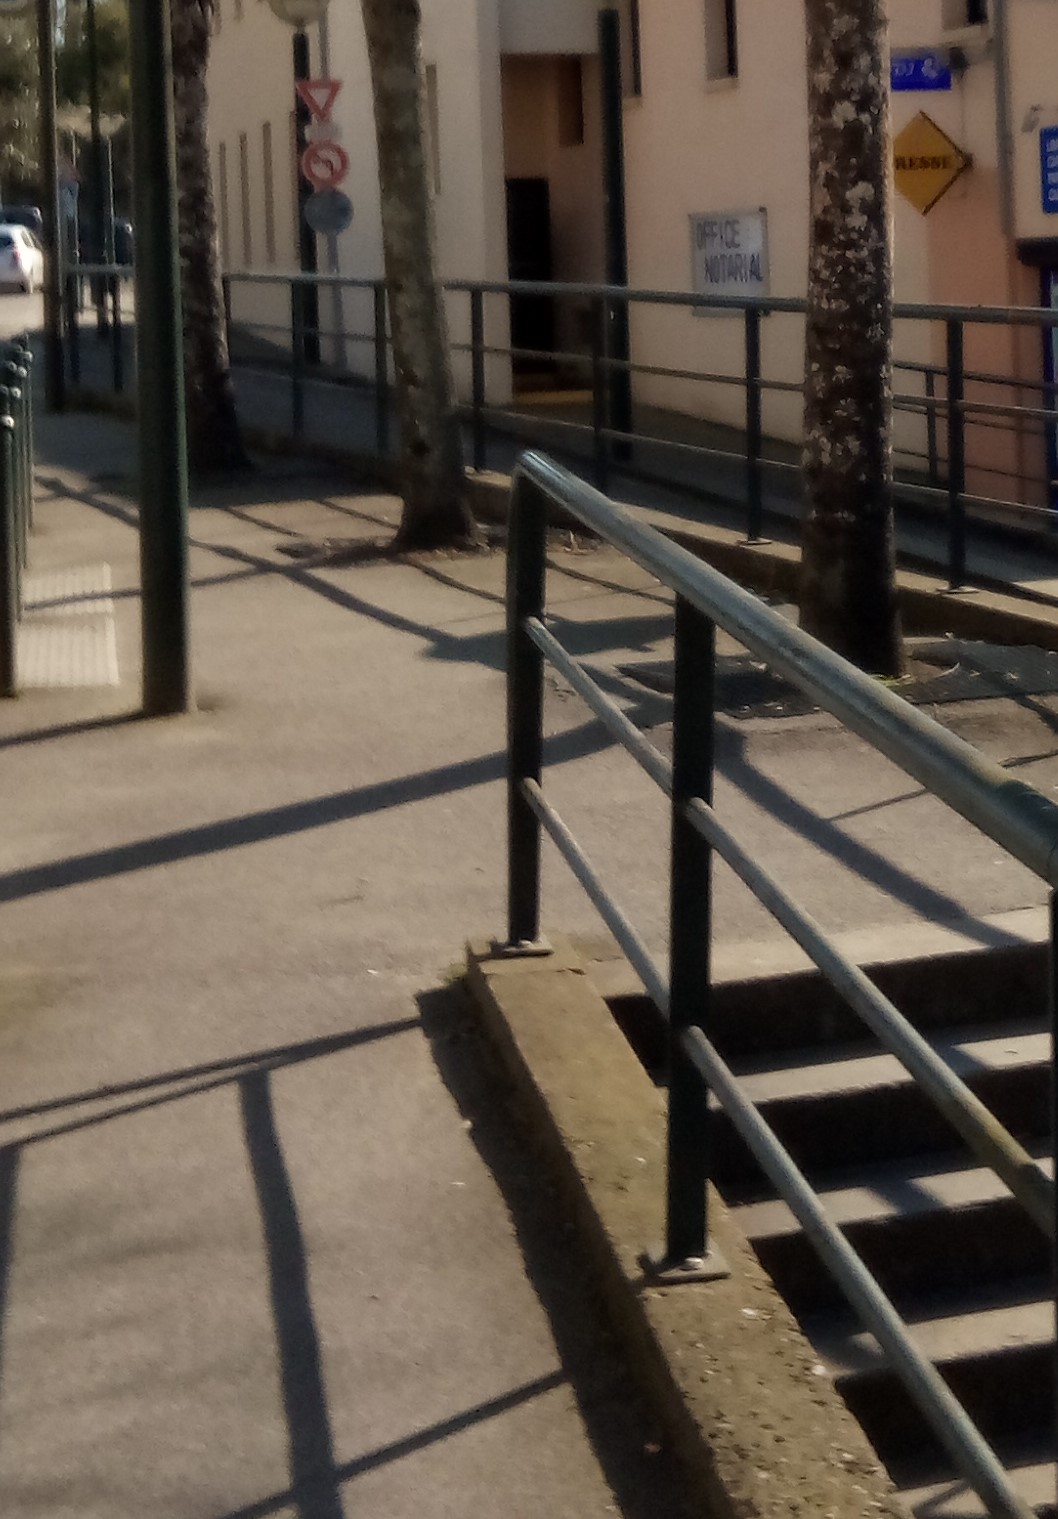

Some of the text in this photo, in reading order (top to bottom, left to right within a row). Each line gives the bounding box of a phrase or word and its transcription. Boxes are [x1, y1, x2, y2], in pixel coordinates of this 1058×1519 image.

[893, 154, 952, 171] RESSE
[696, 219, 741, 250] OFFICE
[704, 252, 763, 284] NOTARIAL
